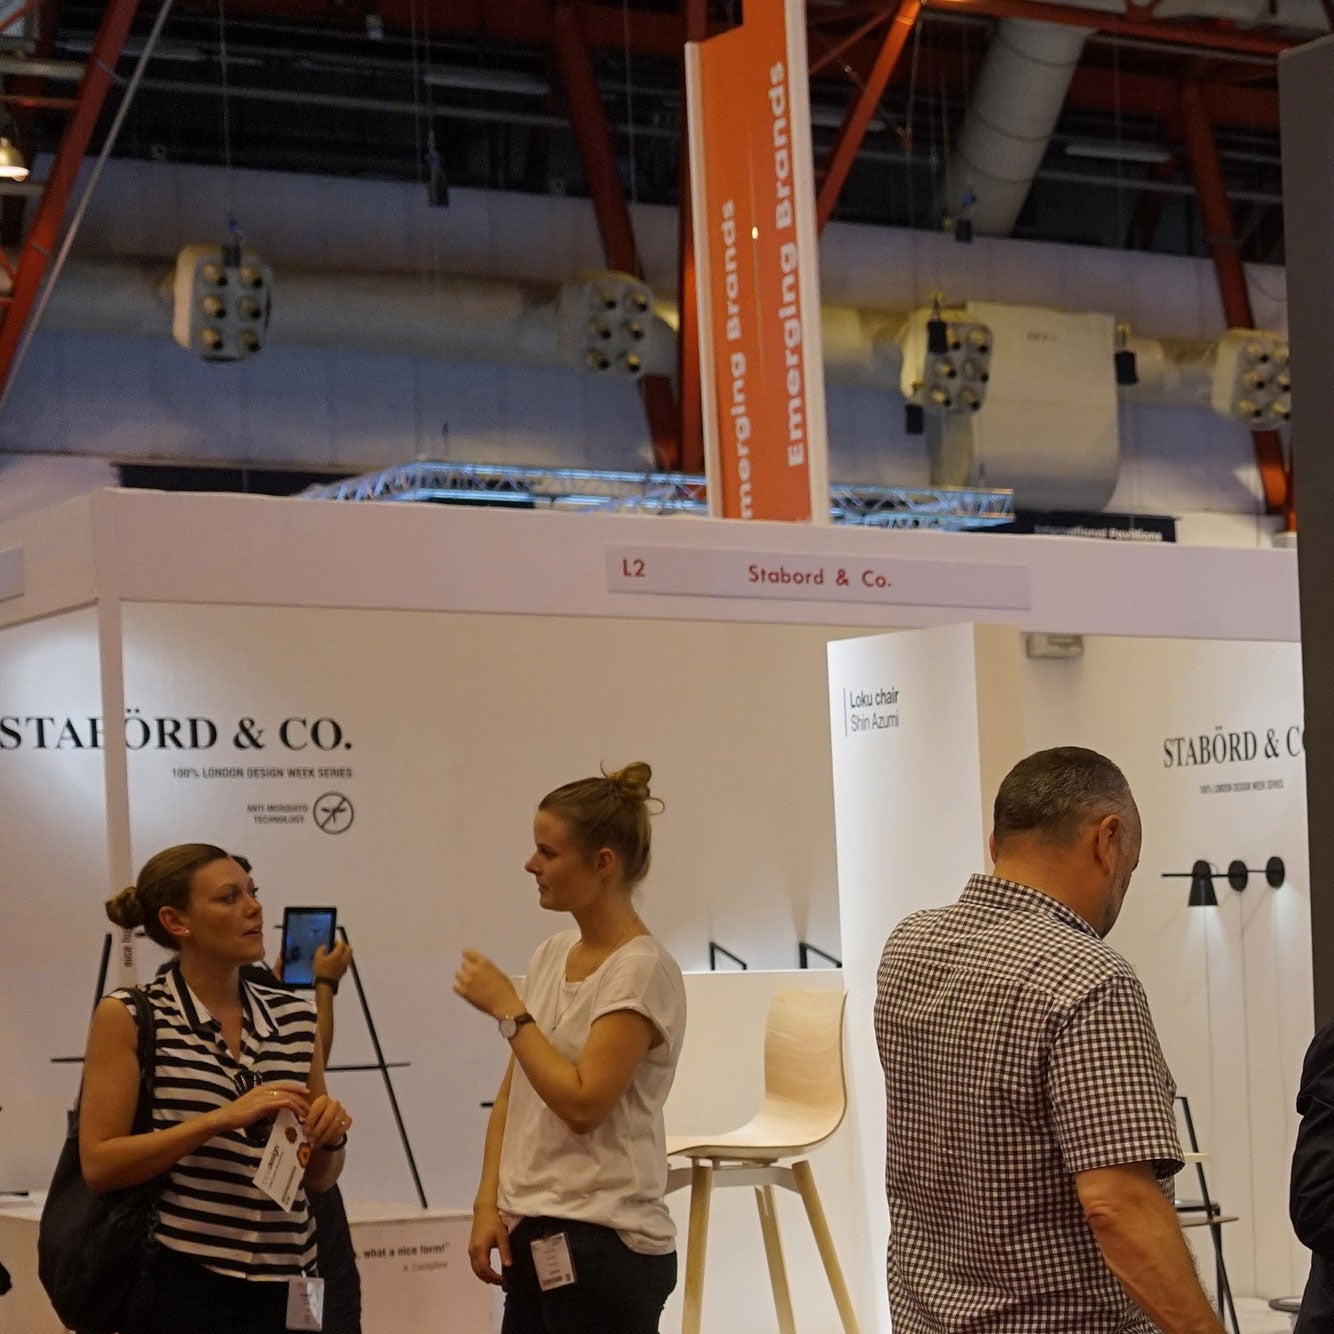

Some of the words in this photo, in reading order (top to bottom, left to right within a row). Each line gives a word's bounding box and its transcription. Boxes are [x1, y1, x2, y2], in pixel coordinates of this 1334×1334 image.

[769, 61, 793, 230] Brands
[721, 200, 742, 342] Brands
[779, 240, 804, 468] Emerging
[726, 351, 753, 519] merging
[622, 559, 646, 578] L2
[747, 564, 824, 586] Stabord
[835, 569, 849, 587] &
[861, 570, 892, 588] Co.
[850, 690, 873, 708] Loku
[875, 686, 899, 705] chair
[232, 716, 266, 750] &
[279, 716, 353, 751] CO.
[850, 713, 871, 732] Shin
[872, 710, 899, 730] Azumi
[1162, 725, 1258, 769] STABÖRD
[1263, 728, 1280, 760] &
[1286, 725, 1304, 757] C
[202, 767, 244, 779] LONDON
[247, 767, 284, 779] DESIGN
[287, 767, 314, 779] WEEK
[317, 766, 353, 779] SERIES
